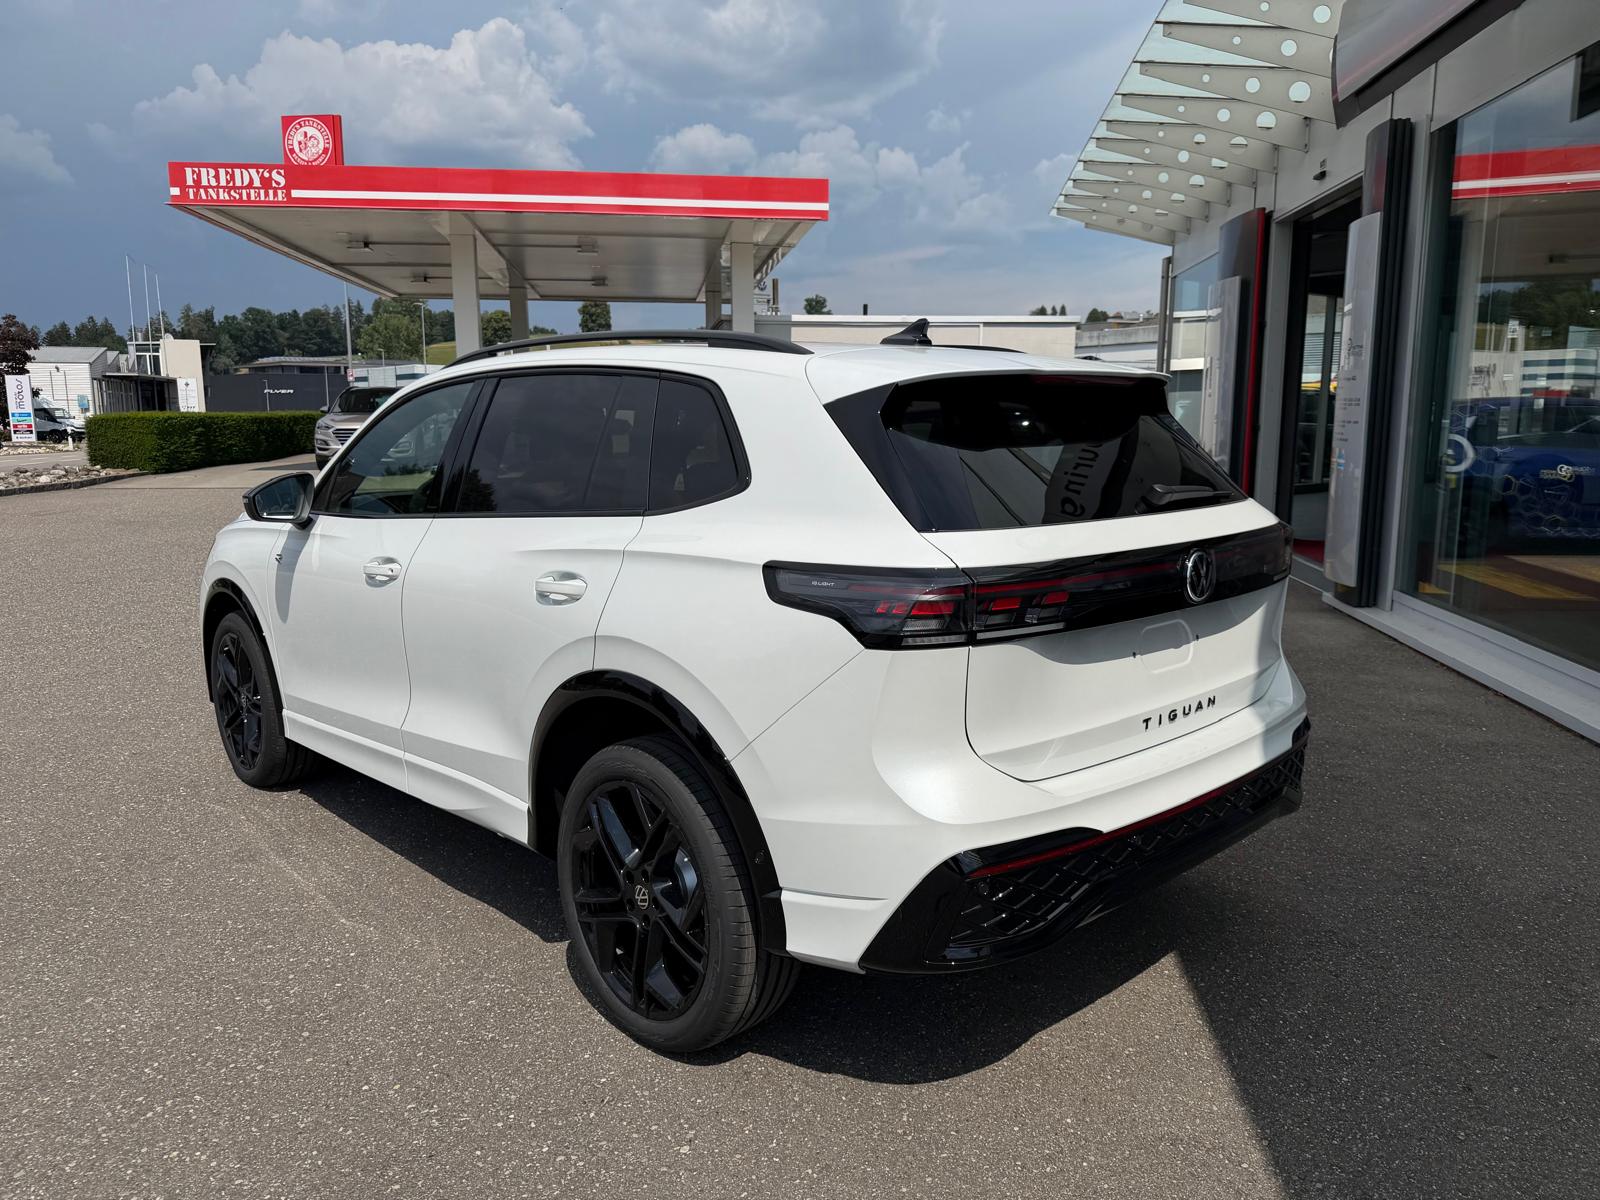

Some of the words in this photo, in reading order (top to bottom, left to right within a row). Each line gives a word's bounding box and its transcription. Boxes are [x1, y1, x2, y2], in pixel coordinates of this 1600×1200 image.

[184, 167, 286, 188] FREDY'S
[185, 188, 287, 201] TANKSTELLE
[1142, 695, 1216, 732] TIGUAN
